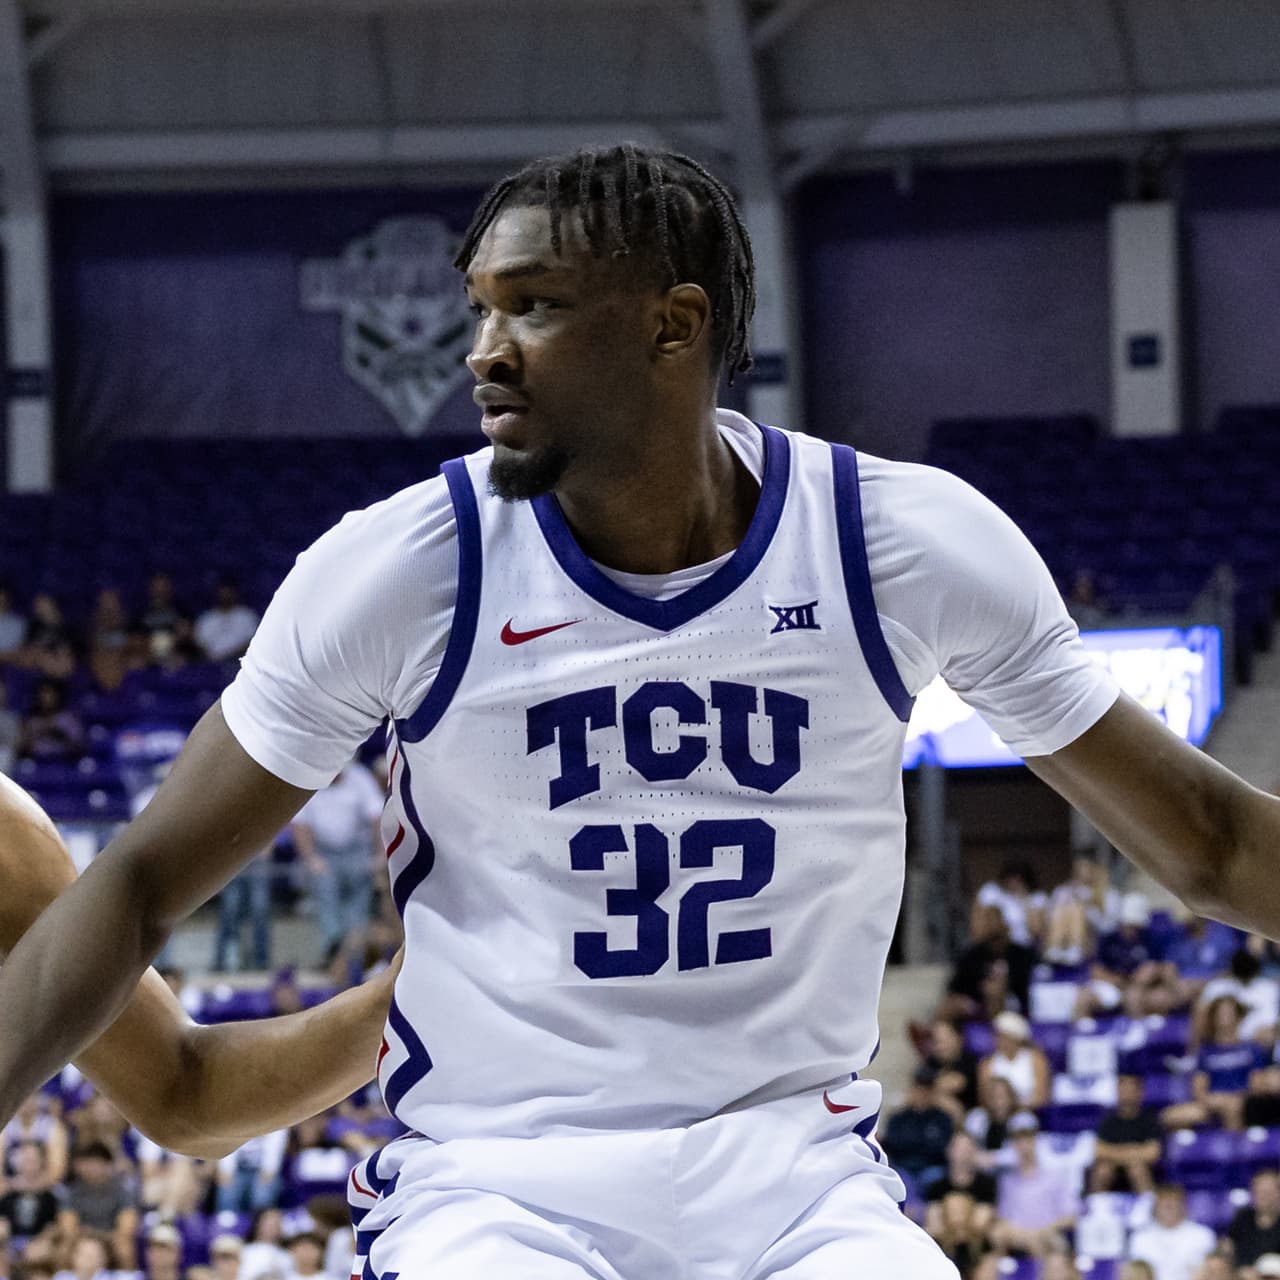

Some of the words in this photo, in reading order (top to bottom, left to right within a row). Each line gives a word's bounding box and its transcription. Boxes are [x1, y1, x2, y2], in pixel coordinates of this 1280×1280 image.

[767, 599, 821, 635] XII
[526, 681, 809, 811] TCU
[569, 818, 776, 979] 32
